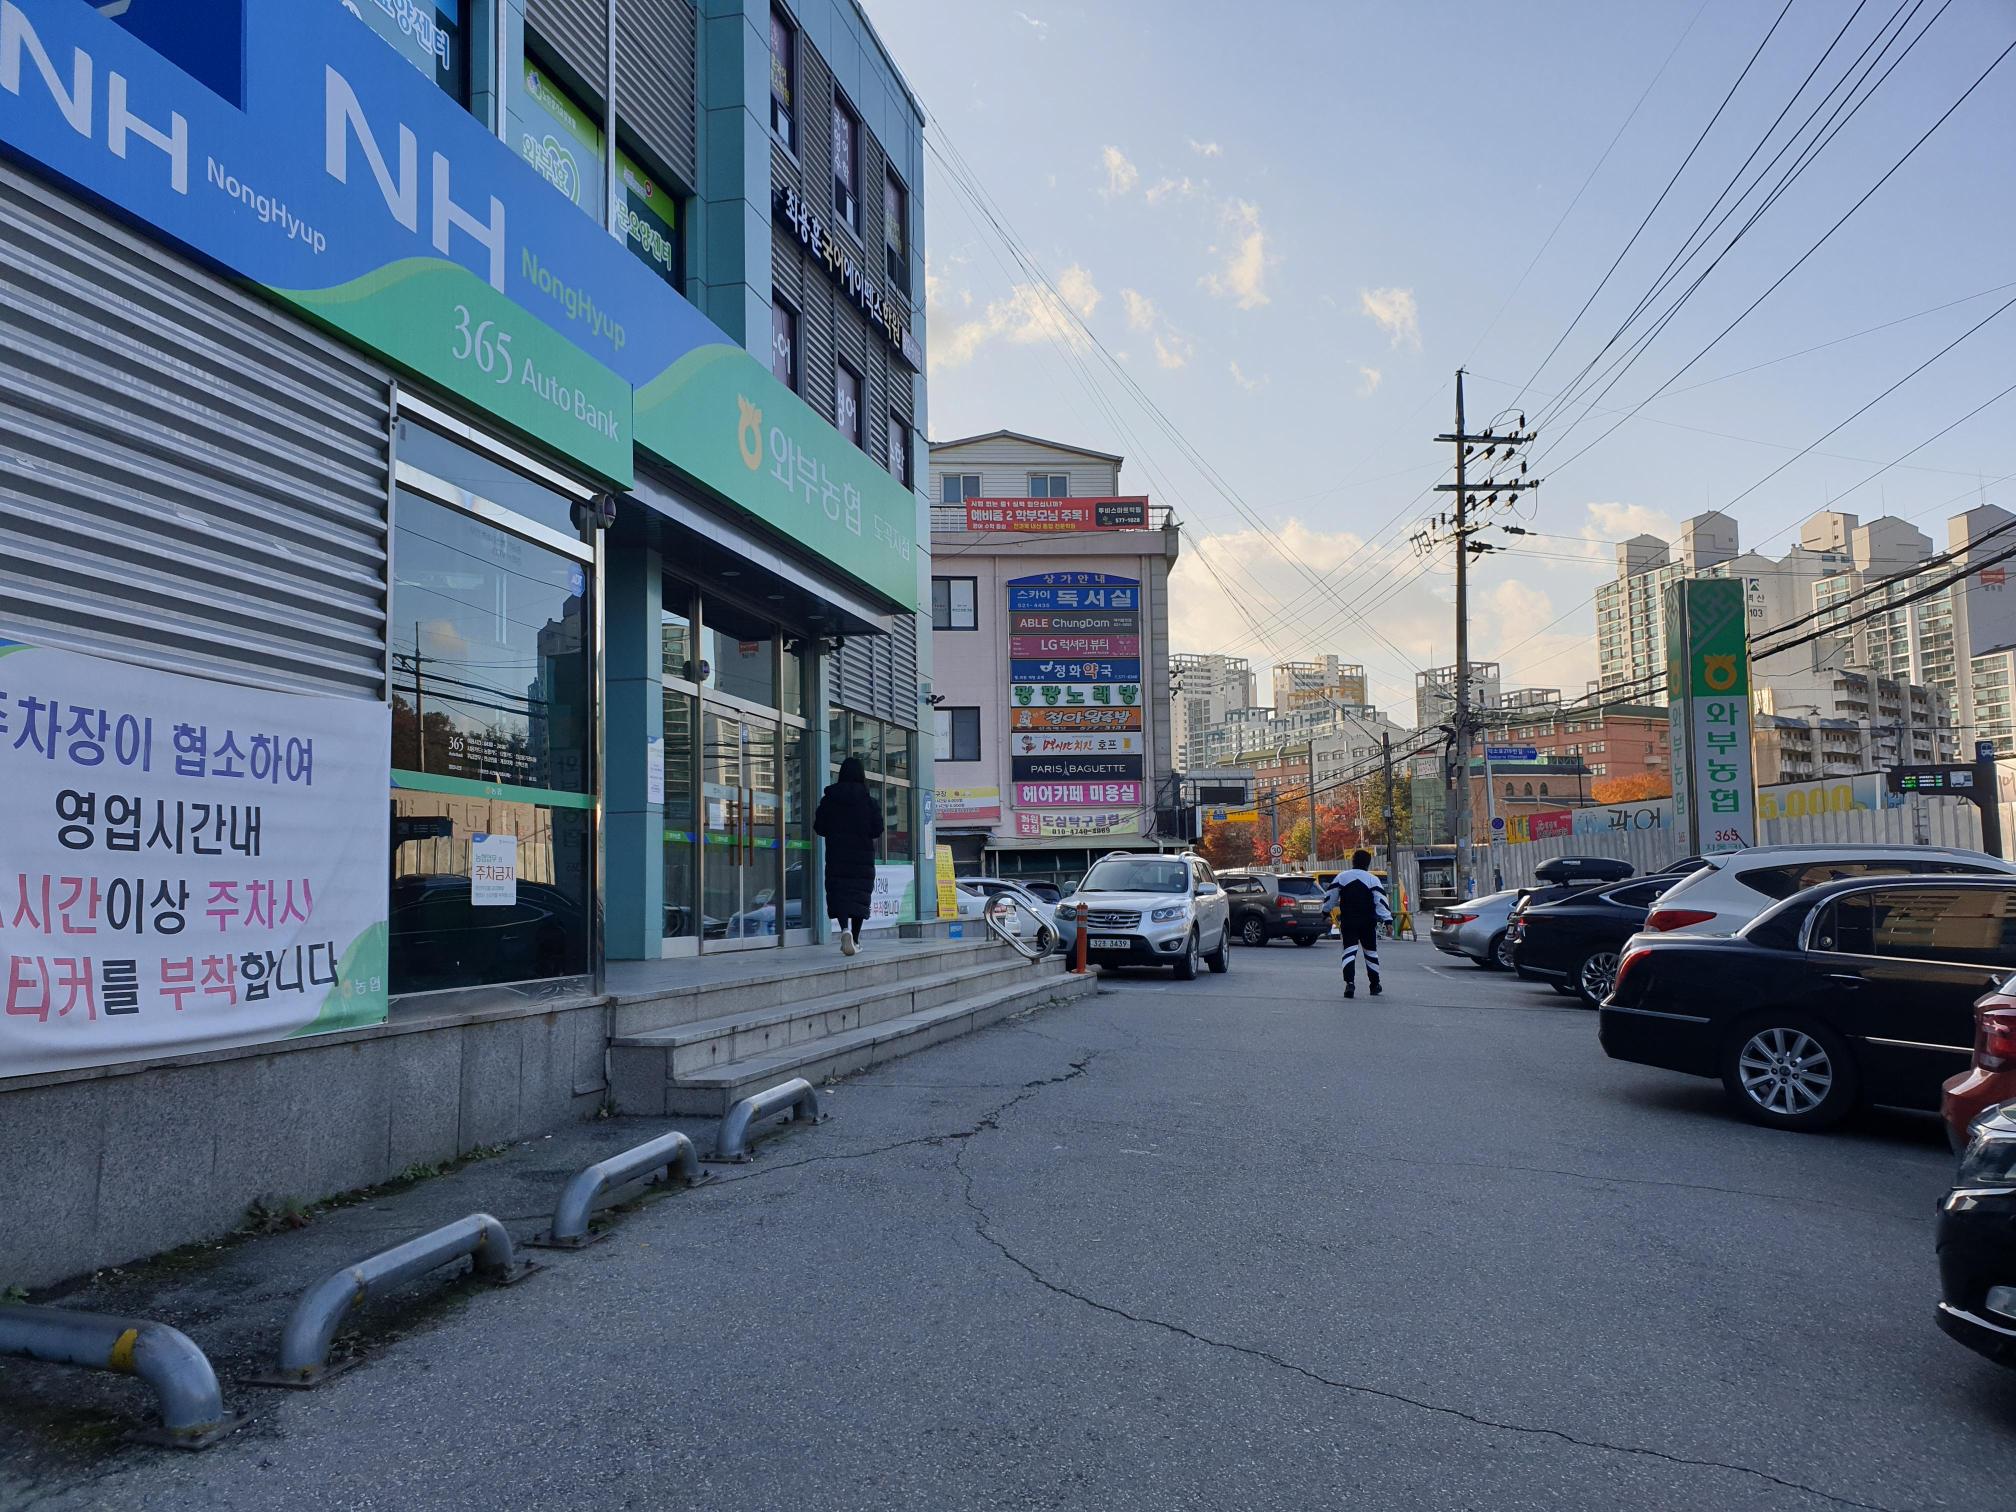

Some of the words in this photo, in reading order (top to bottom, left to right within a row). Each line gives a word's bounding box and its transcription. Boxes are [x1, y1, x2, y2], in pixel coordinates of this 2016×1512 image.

[368, 0, 449, 70] 양센터
[0, 8, 188, 195] NH
[207, 156, 326, 254] NongHyup
[326, 65, 504, 293] NH
[522, 247, 625, 351] NongHyup
[454, 305, 513, 384] 365
[769, 426, 861, 536] 와부농협
[1006, 510, 1013, 521] 2
[1016, 509, 1058, 522] 학부모님
[1061, 509, 1082, 521] 주목
[1043, 574, 1105, 584] 상가안내
[1017, 590, 1050, 599] 스카이
[1056, 589, 1131, 608] 독서실
[1020, 618, 1049, 628] ABLE
[1052, 618, 1110, 629] ChungDam
[1041, 640, 1058, 651] LG
[1054, 662, 1113, 680] 정화약국
[449, 736, 464, 751] 365
[1098, 740, 1118, 750] 호프
[173, 722, 313, 786] 협소하여
[1705, 702, 1740, 813] 와부농협
[1031, 765, 1063, 773] PARIS
[1070, 764, 1126, 773] BAGUETTE
[1023, 785, 1084, 803] 헤어카페
[1089, 784, 1135, 802] 미용실
[55, 789, 261, 857] 영업시간내
[475, 865, 514, 881] 주차금지
[0, 873, 190, 934] 시간이상
[206, 878, 314, 932] 주차시
[5, 955, 140, 1022] 티커를
[160, 941, 339, 1010] 부착합니다
